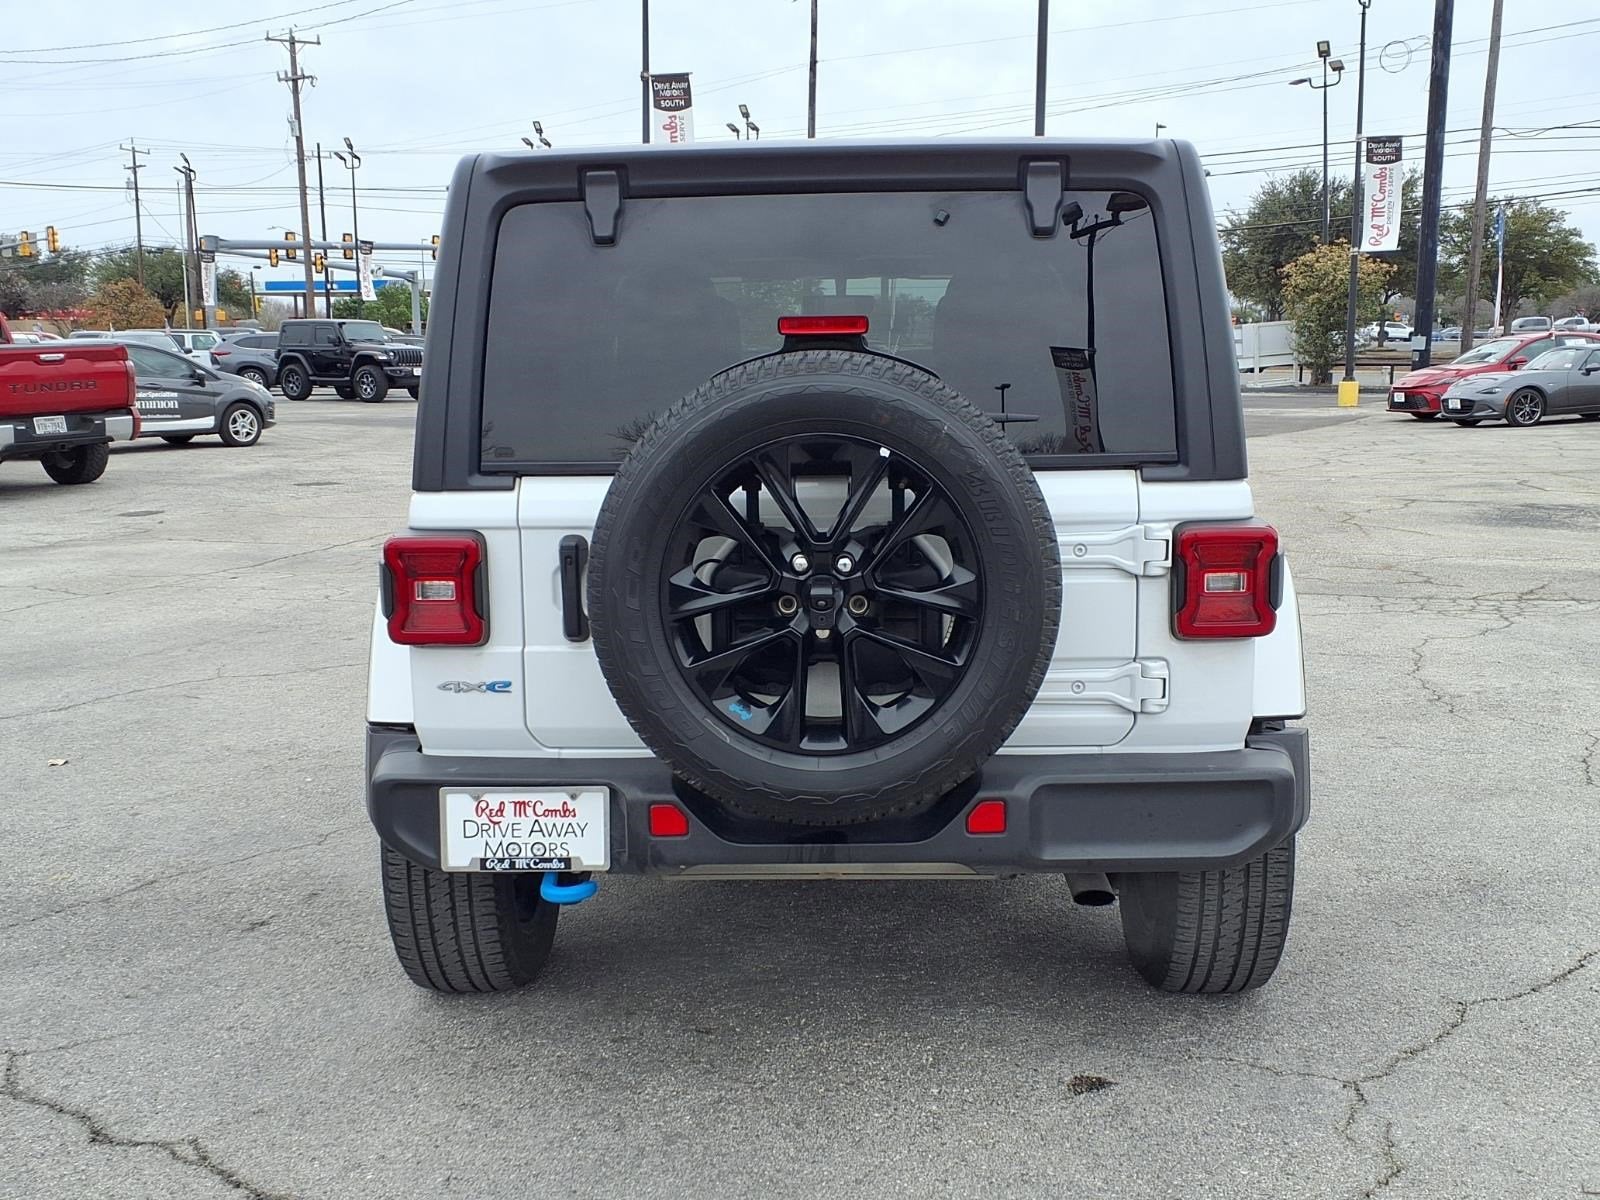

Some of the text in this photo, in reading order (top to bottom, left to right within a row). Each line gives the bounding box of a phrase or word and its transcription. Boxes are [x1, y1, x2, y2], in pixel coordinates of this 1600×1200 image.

[660, 100, 685, 108] SOUTH
[1368, 166, 1390, 246] Red McCombs
[8, 380, 97, 394] TUNDRA
[475, 800, 576, 826] Red McCombs
[463, 819, 589, 838] DRIVE AWAY
[484, 840, 570, 858] MOTORS
[486, 858, 566, 870] Red McCombs
